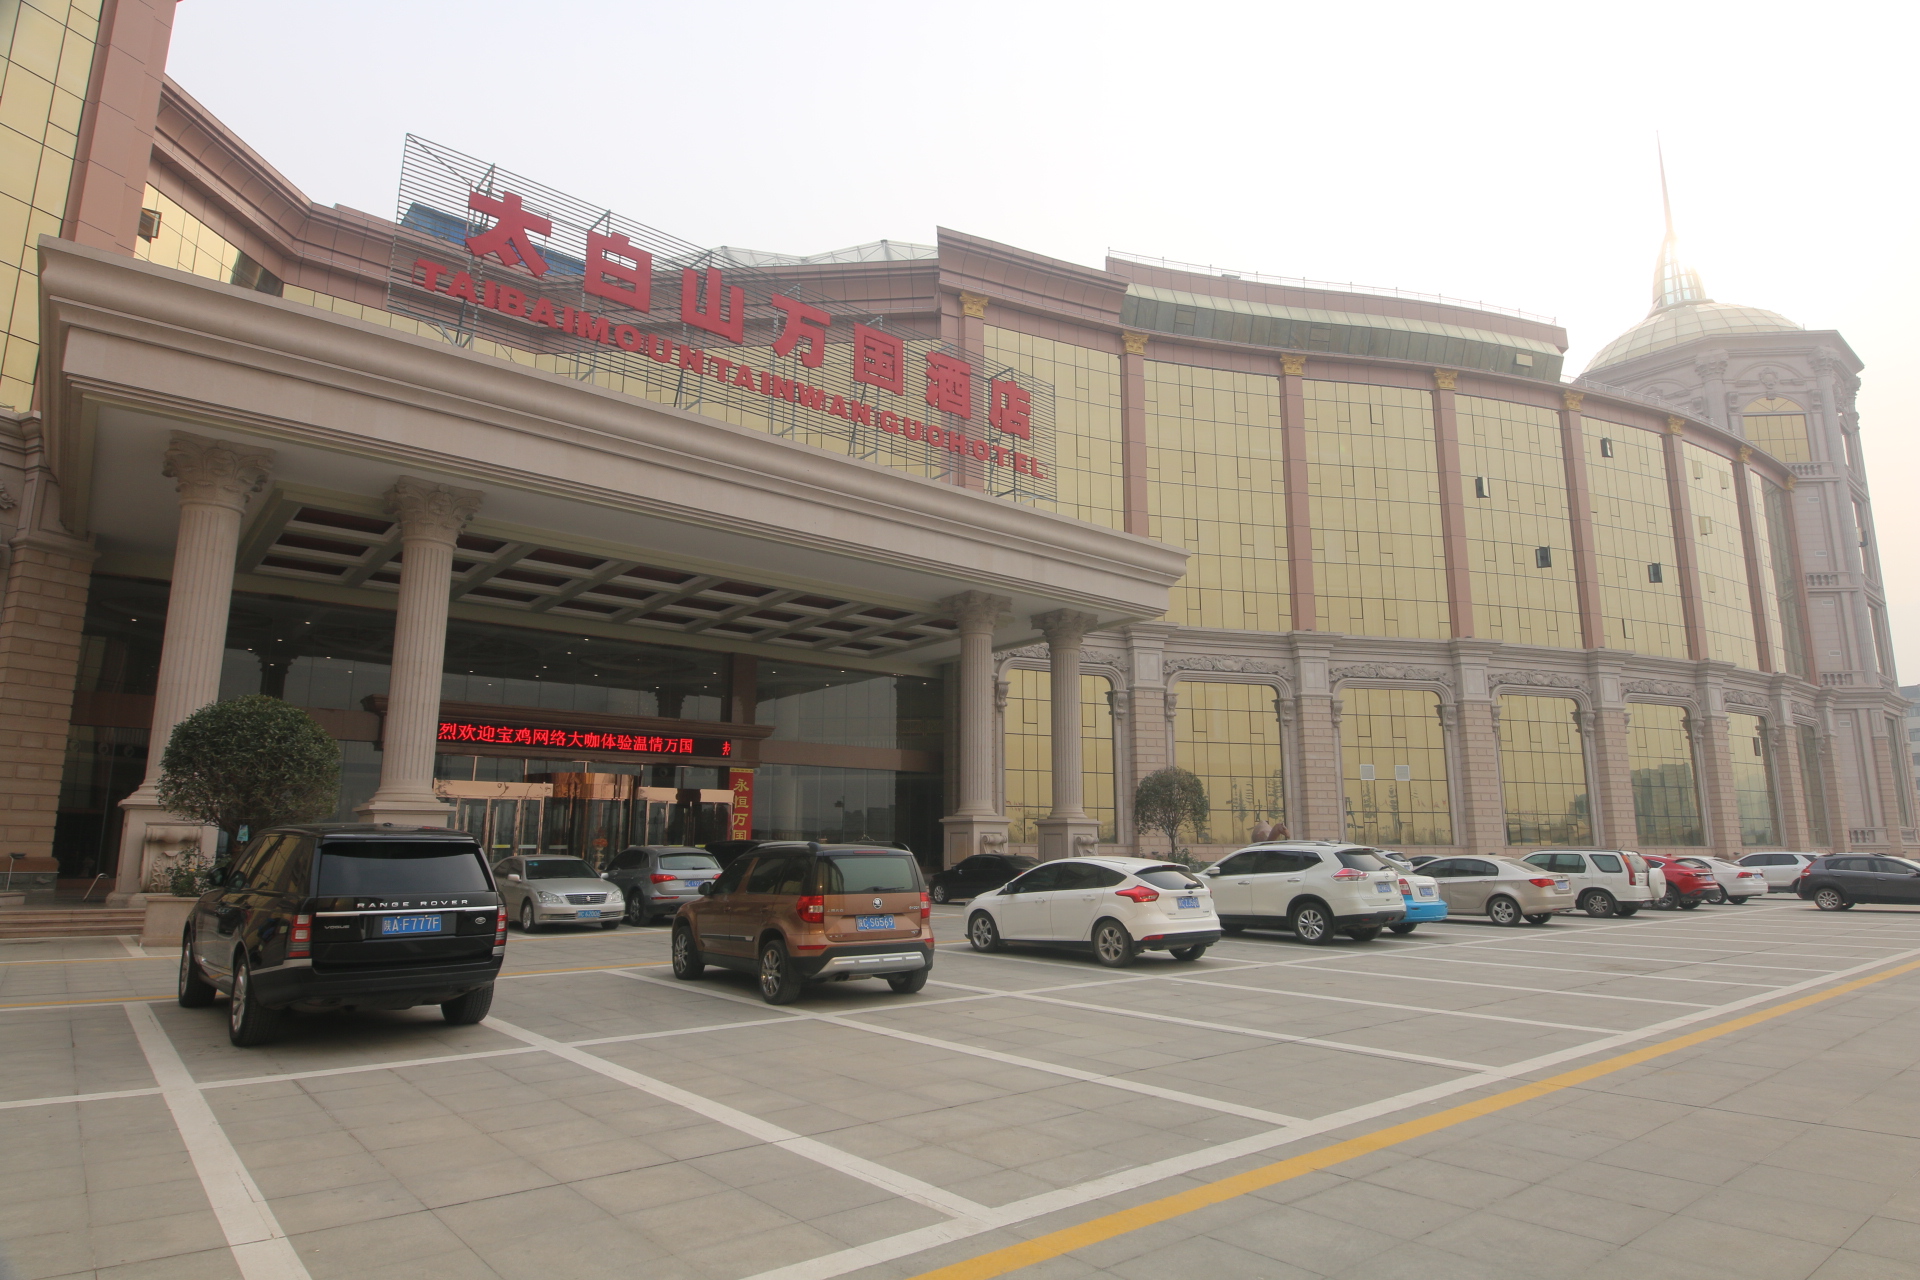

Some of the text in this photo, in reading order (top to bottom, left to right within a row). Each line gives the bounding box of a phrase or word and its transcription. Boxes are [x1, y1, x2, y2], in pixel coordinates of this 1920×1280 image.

[464, 191, 1031, 441] 太白山万国酒店
[733, 778, 750, 840] 永恒万国
